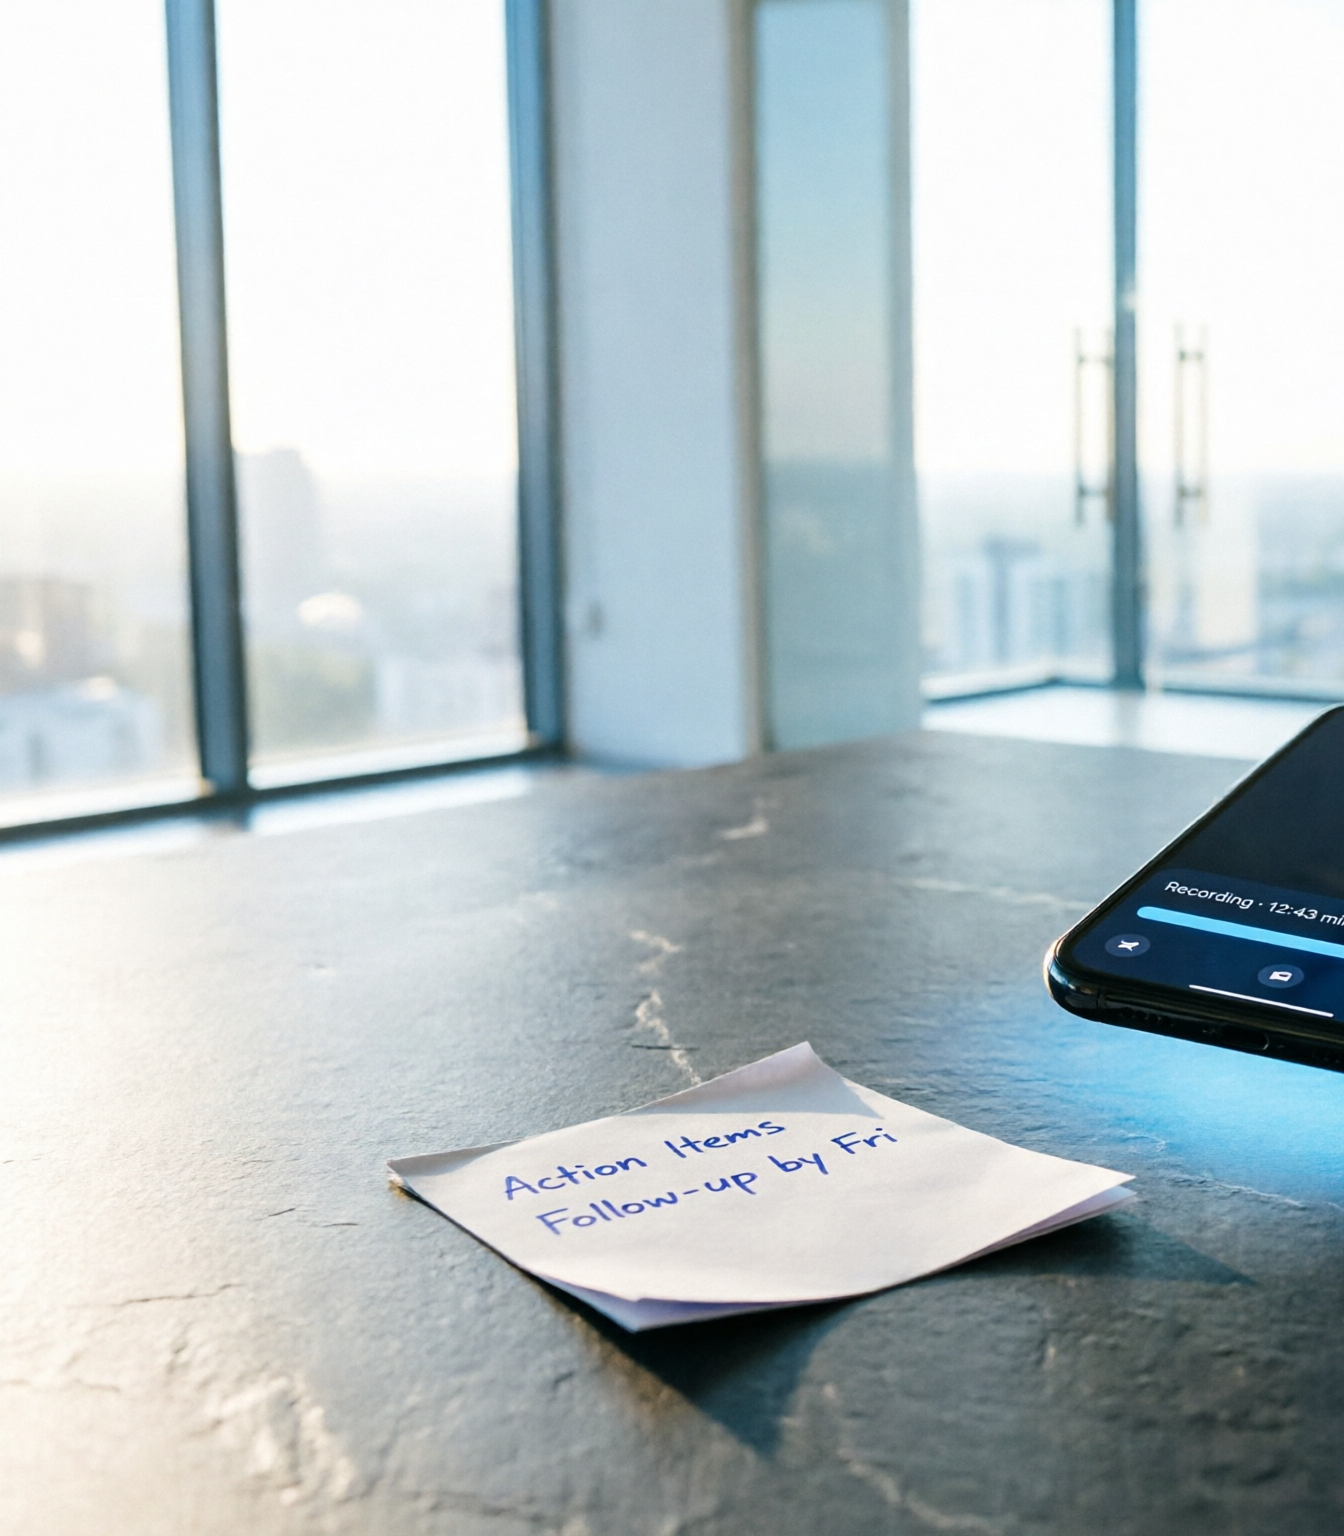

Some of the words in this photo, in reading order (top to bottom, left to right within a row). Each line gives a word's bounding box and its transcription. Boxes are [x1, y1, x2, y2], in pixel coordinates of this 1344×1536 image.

[1164, 881, 1254, 910] Recording
[1268, 901, 1318, 921] 12:43
[504, 1156, 648, 1200] Action
[663, 1120, 786, 1158] Items
[535, 1171, 759, 1236] Follow-up
[767, 1153, 829, 1176] by
[830, 1127, 899, 1155] Fri
